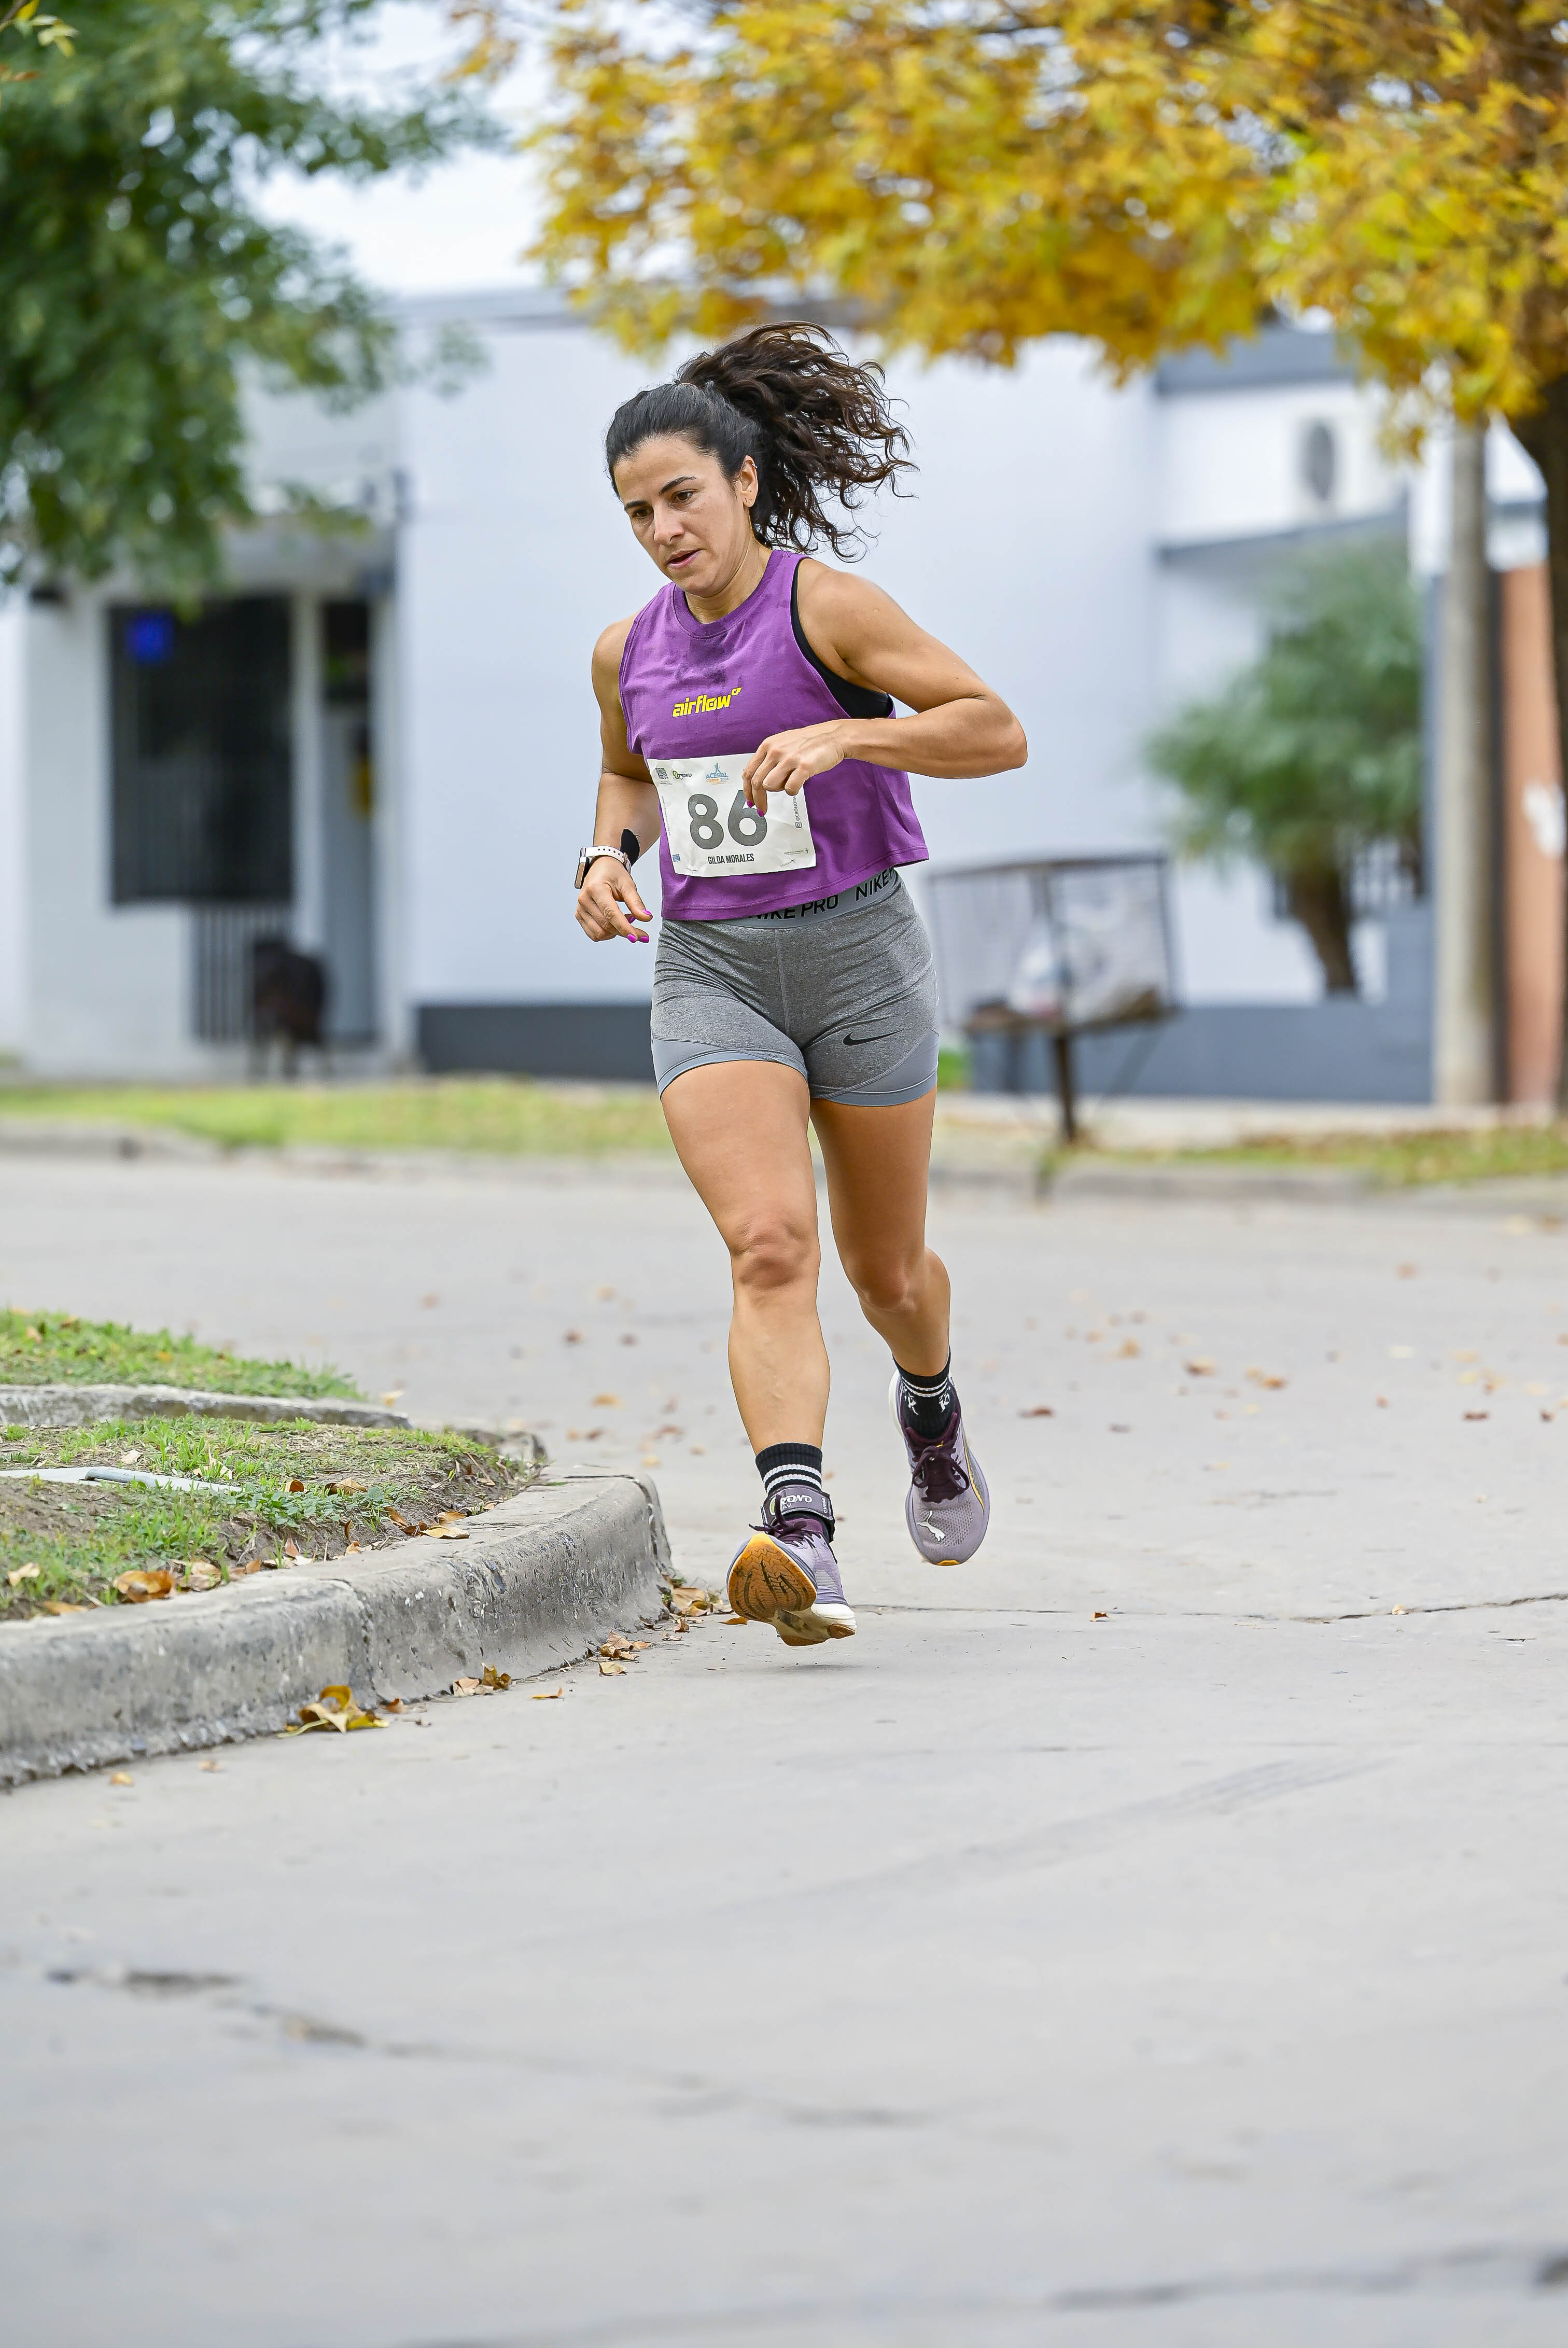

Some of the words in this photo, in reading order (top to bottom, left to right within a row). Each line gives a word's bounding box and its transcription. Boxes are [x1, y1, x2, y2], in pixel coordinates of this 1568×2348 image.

[672, 694, 731, 717] airflow
[688, 790, 767, 849] 86
[708, 855, 725, 864] GILDA
[726, 853, 755, 863] MORALES
[856, 869, 889, 901] NIKE
[801, 894, 839, 917] PRO
[780, 1494, 813, 1505] RONO
